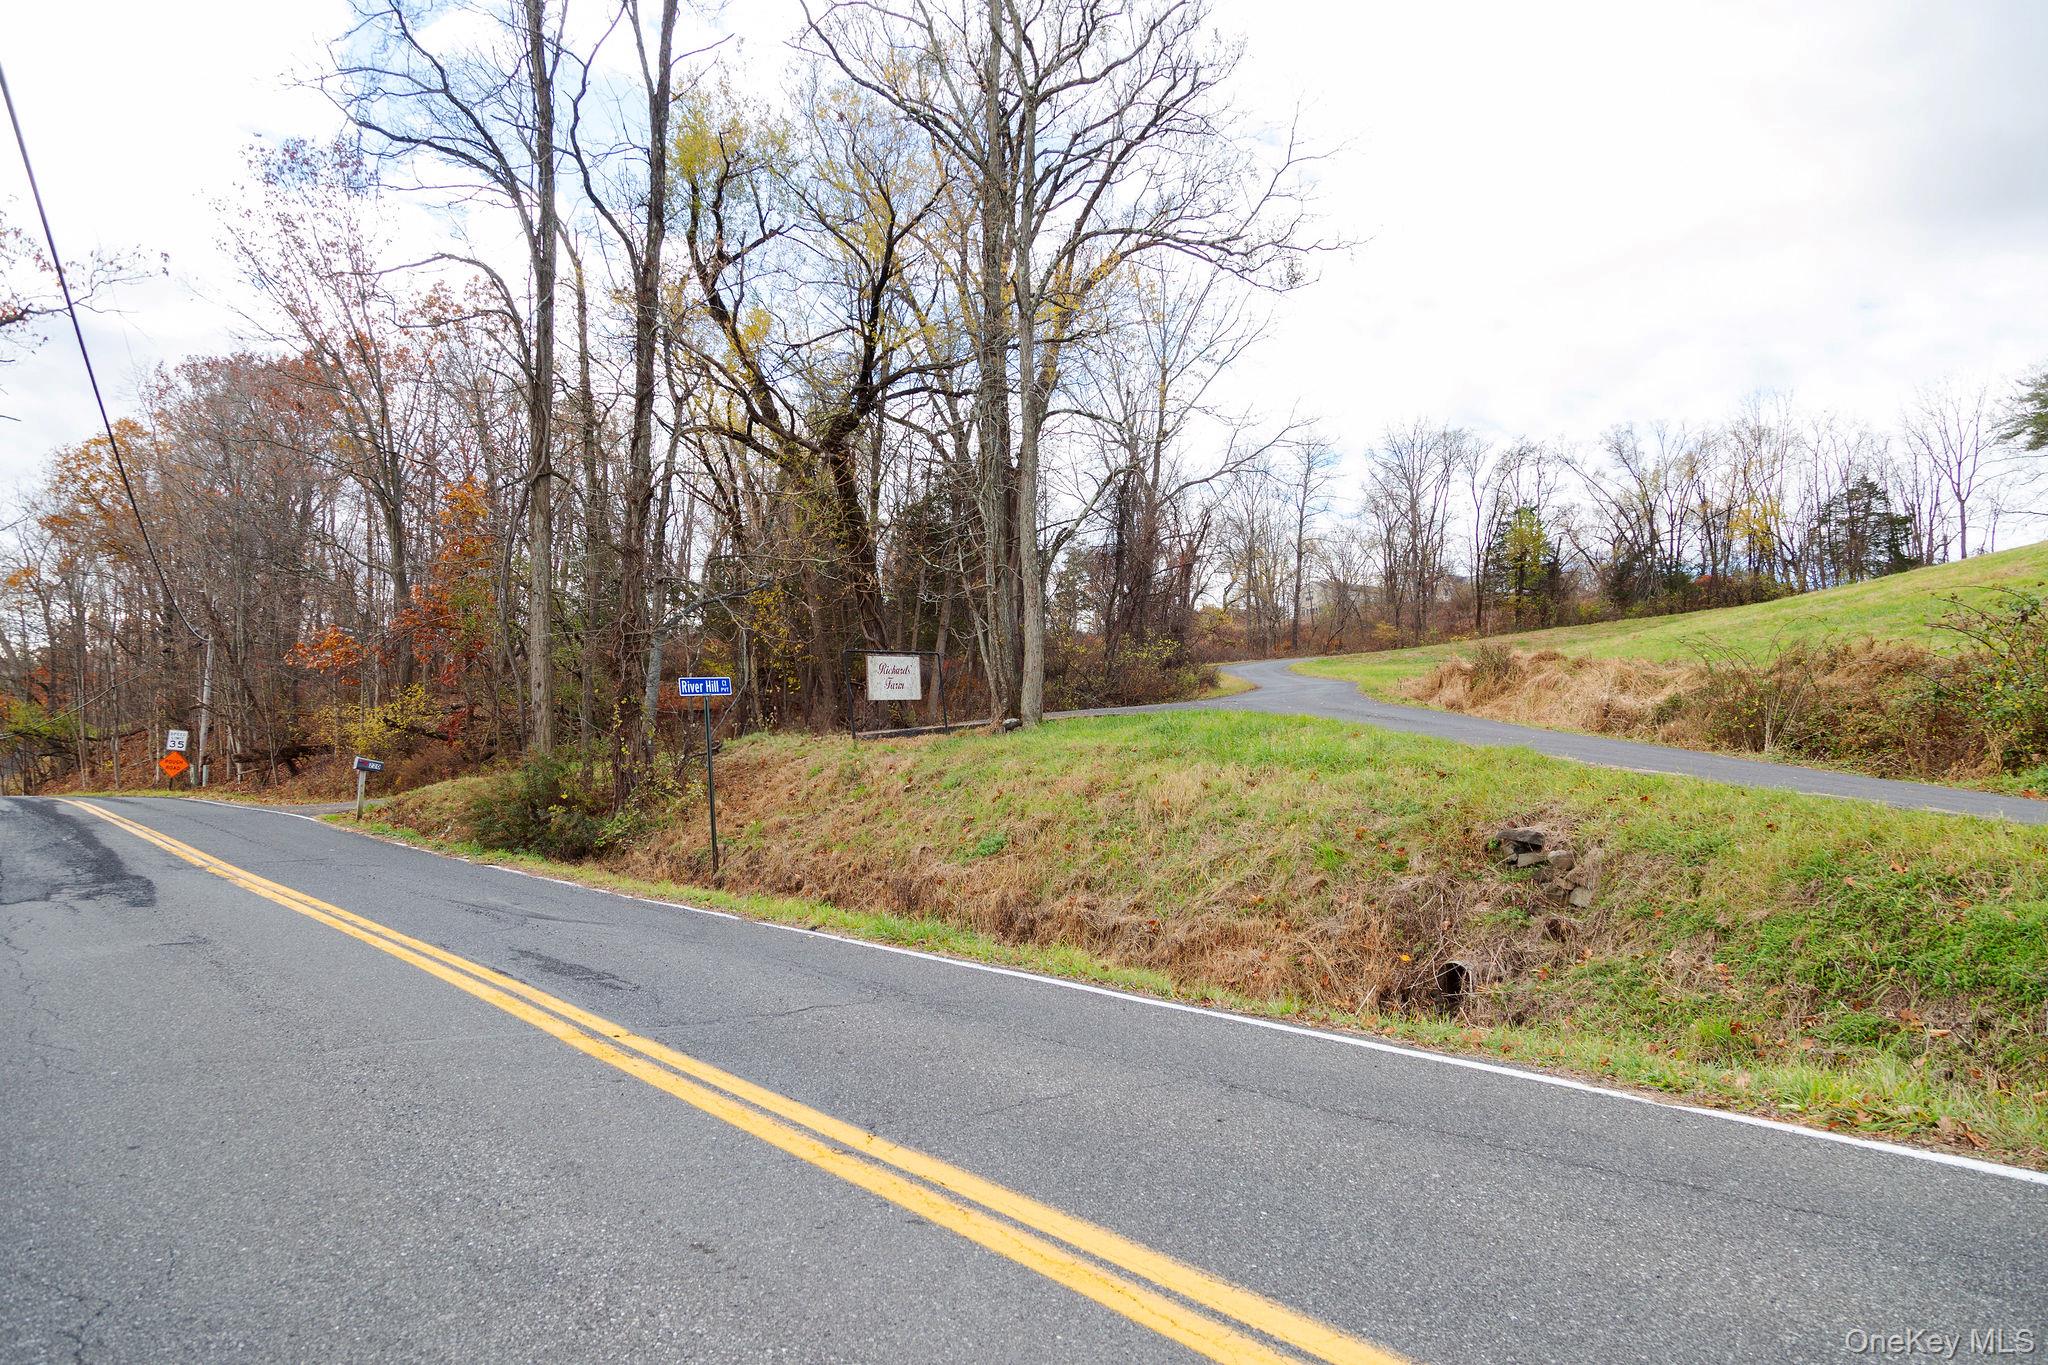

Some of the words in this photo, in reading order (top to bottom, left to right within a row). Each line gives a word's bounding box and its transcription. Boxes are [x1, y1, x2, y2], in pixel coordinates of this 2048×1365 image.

[681, 680, 703, 693] River
[705, 680, 719, 692] Hill
[169, 740, 184, 749] 35
